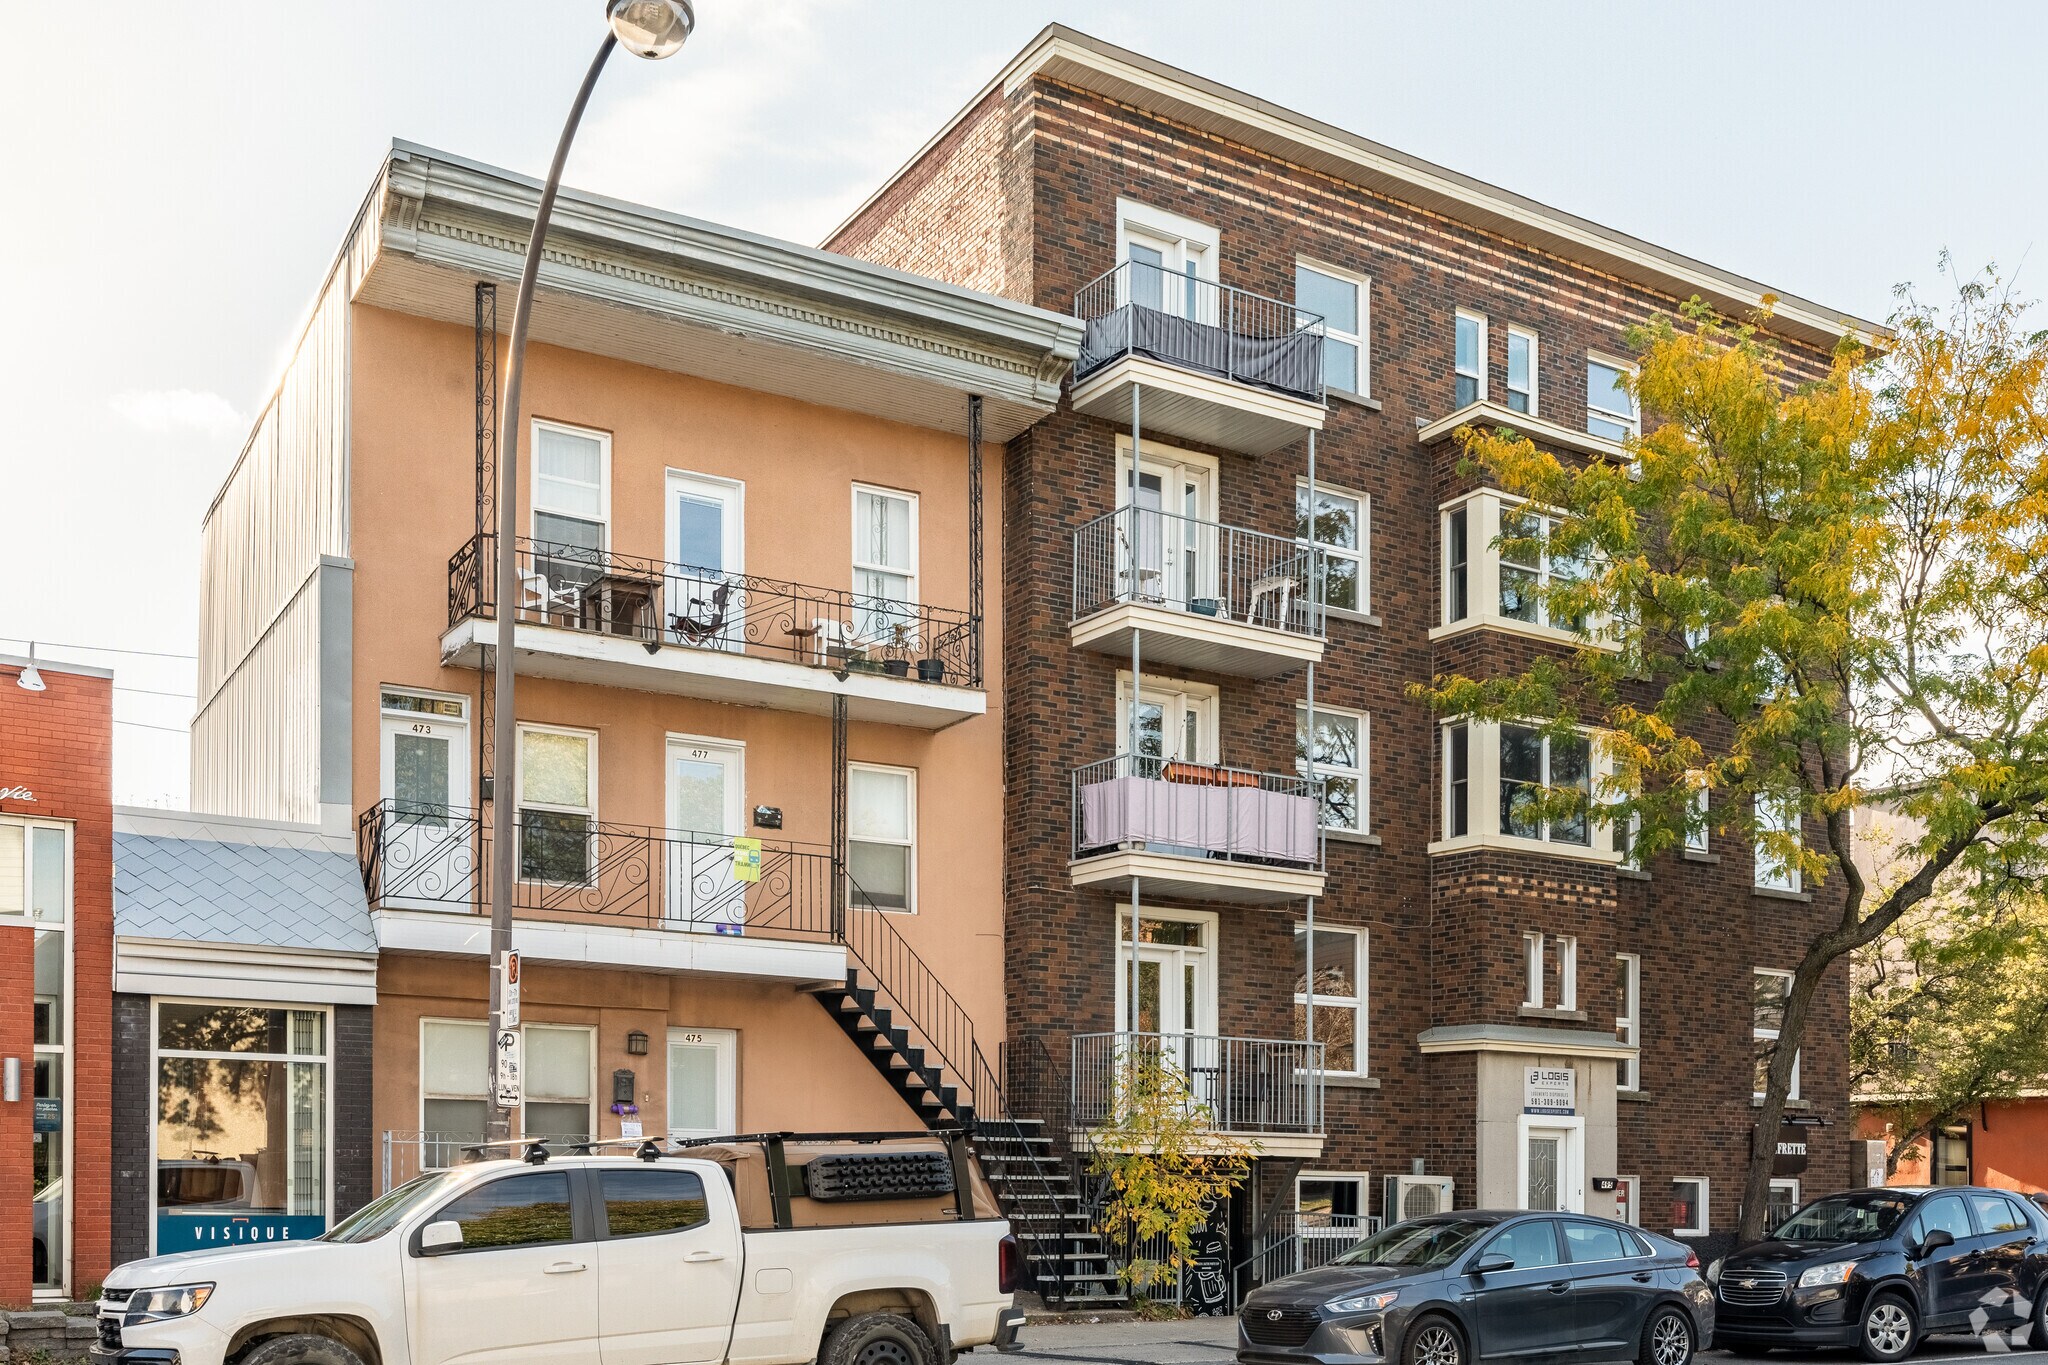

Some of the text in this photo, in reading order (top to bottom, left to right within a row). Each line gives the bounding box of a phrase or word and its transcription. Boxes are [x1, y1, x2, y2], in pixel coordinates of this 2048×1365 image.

[411, 724, 431, 734] 473
[691, 749, 708, 759] 477
[685, 1034, 702, 1043] 475
[1541, 1071, 1569, 1081] LOGIS
[1775, 1142, 1807, 1155] FRETTE
[194, 1226, 290, 1241] VISIQUE
